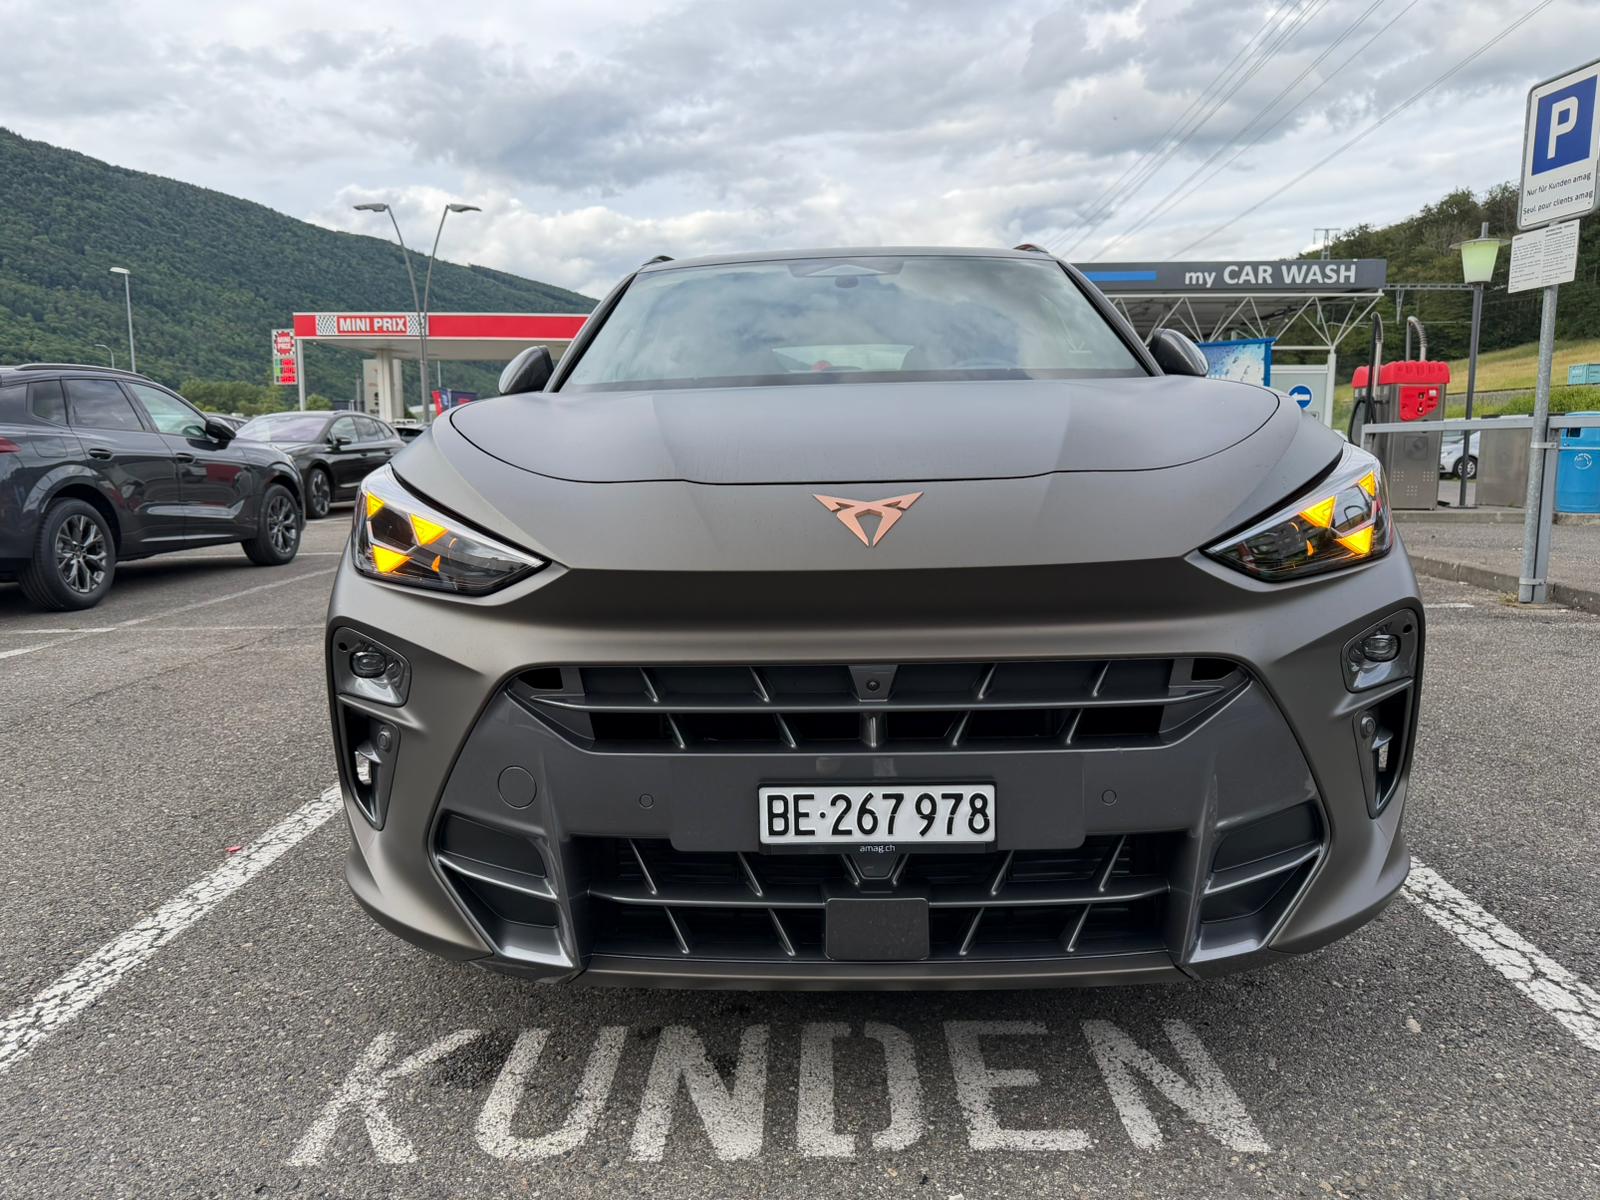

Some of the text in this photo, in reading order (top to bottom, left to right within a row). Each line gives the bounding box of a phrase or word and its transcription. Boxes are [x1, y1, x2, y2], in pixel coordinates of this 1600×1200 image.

[1547, 96, 1579, 160] P
[1526, 171, 1592, 197] Nur für Kunden amag
[1537, 201, 1553, 212] pour
[1553, 195, 1574, 207] clients
[1574, 190, 1594, 200] amag
[1184, 264, 1356, 288] my CAR WASH
[339, 317, 406, 332] MINI PRIX
[859, 844, 896, 854] amag.ch
[286, 1019, 1271, 1167] KUNDEN
